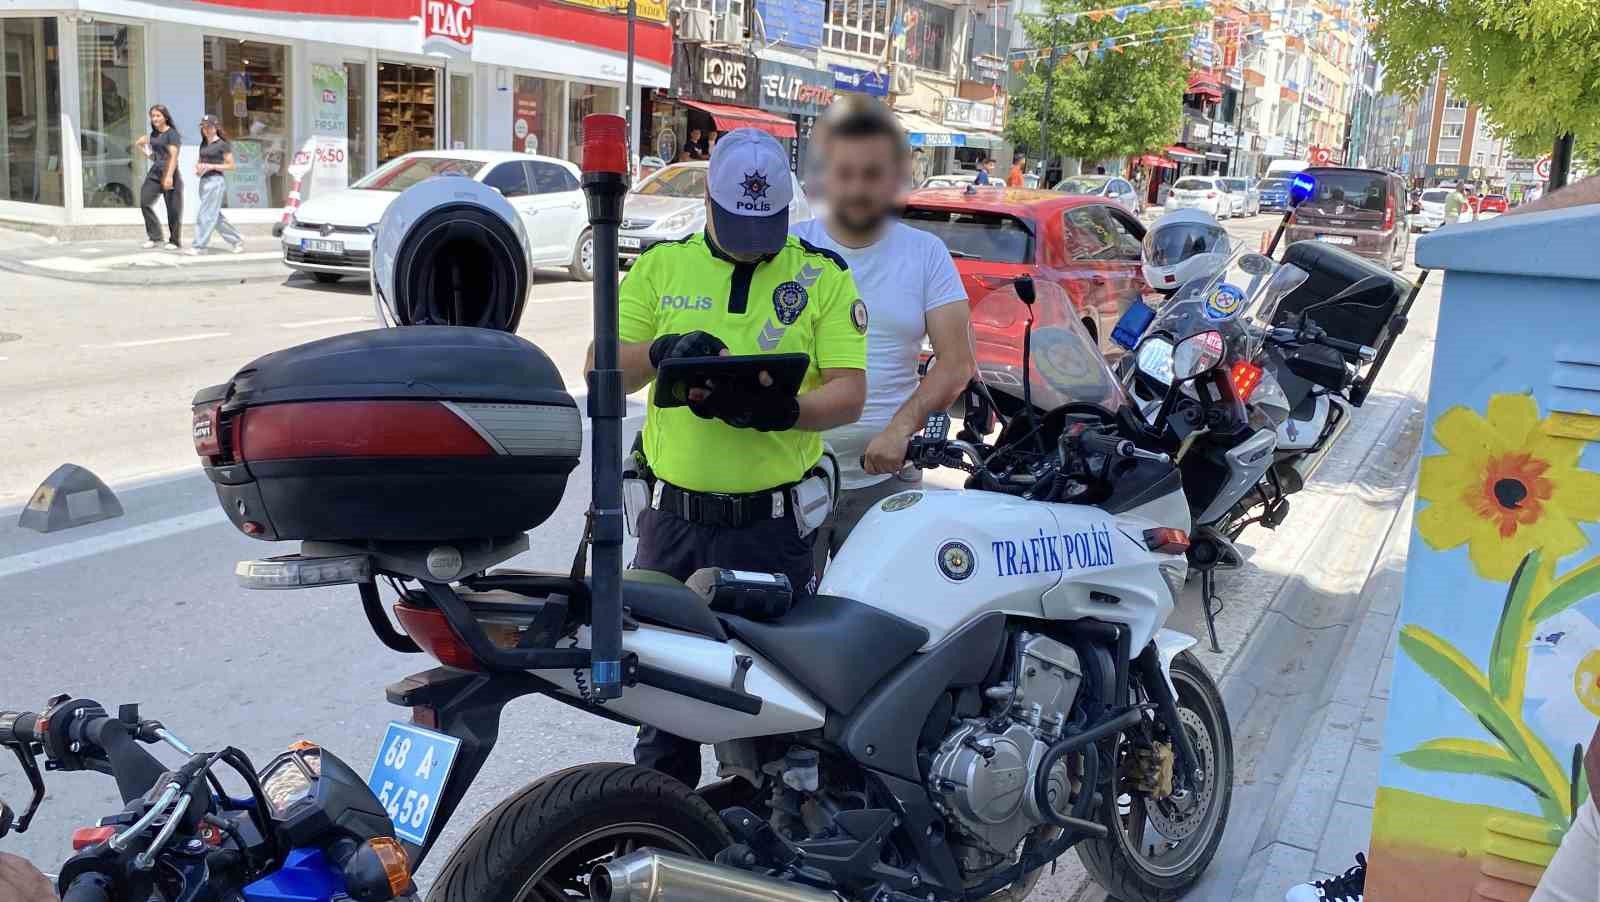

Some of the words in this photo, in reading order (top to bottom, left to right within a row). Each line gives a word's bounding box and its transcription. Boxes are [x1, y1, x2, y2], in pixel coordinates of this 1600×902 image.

[428, 1, 472, 44] TAÇ
[704, 57, 747, 90] LORIS
[316, 147, 344, 162] %50
[736, 200, 771, 212] POLİS
[992, 528, 1062, 576] TRAFİK
[1062, 522, 1115, 570] POLİSİ
[384, 735, 412, 770] 68
[415, 745, 434, 780] A
[379, 780, 430, 829] 5458
